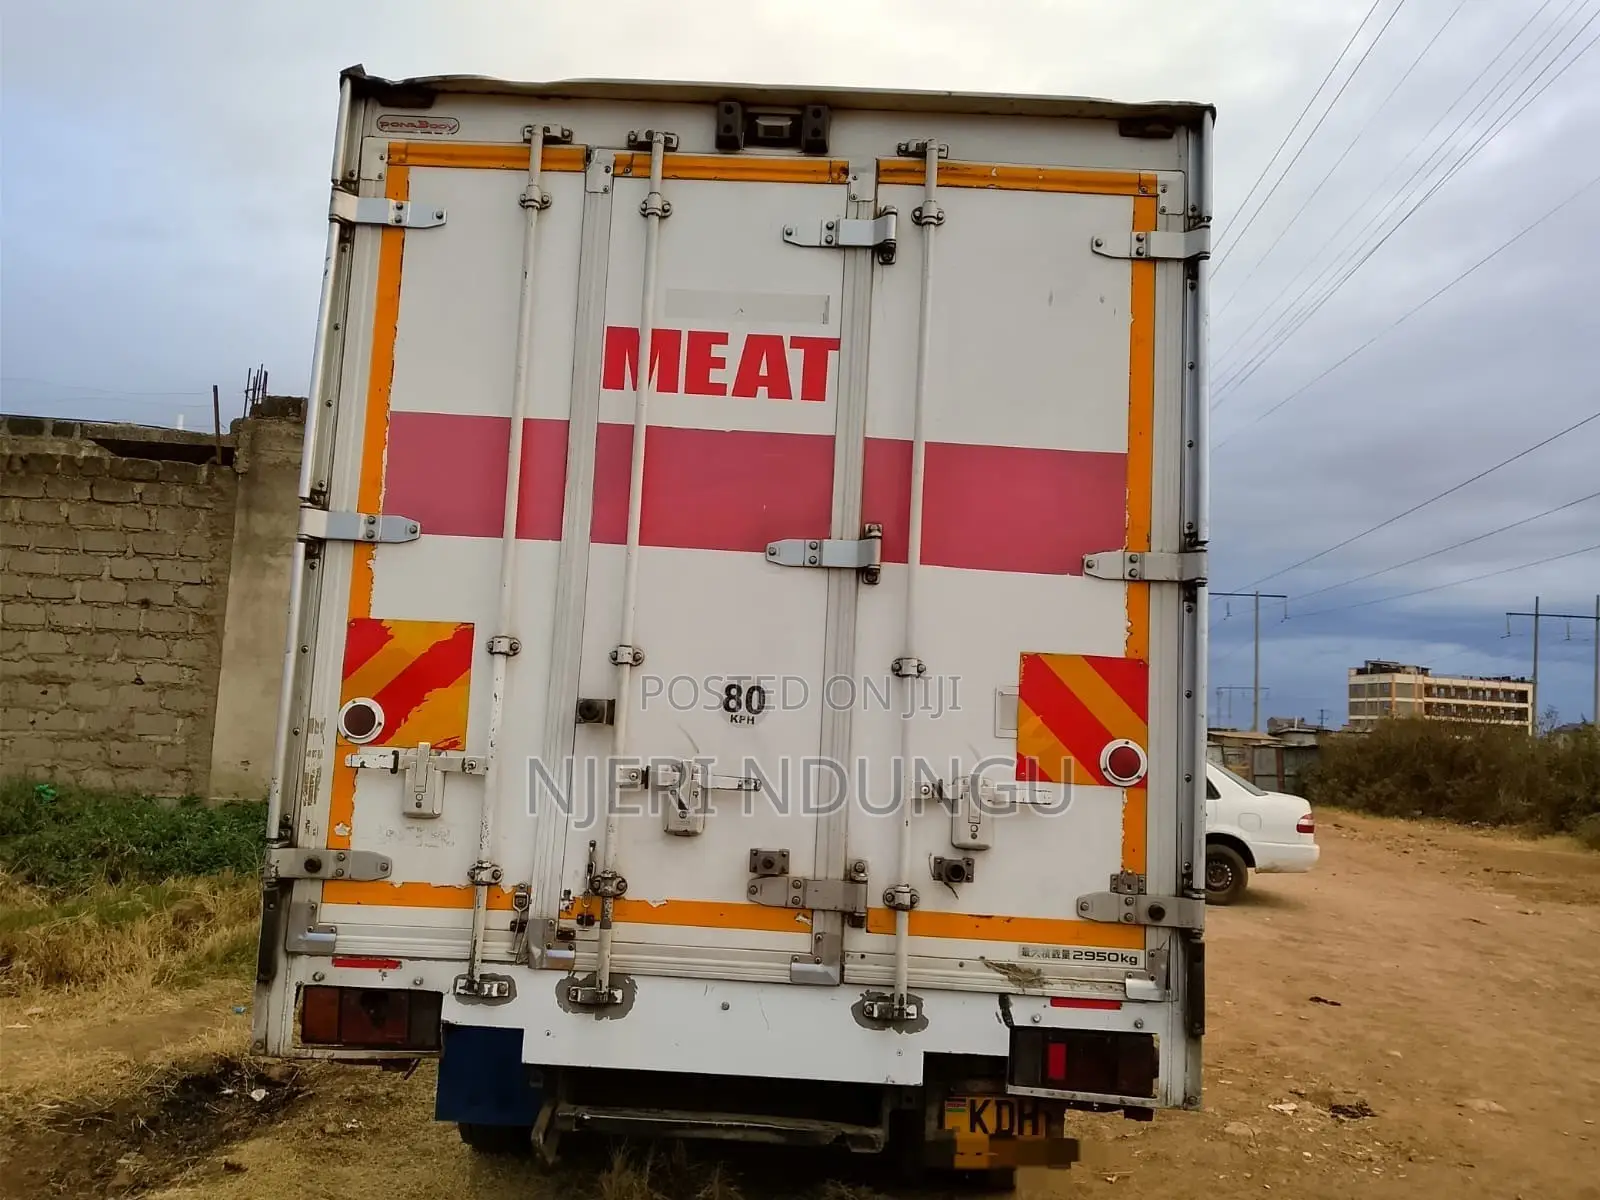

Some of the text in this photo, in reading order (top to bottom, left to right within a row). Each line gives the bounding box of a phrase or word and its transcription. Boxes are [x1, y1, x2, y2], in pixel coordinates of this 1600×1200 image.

[602, 325, 841, 402] MEAT
[722, 683, 767, 715] 80
[729, 713, 755, 725] KPH
[1072, 950, 1138, 966] 2950kg
[969, 1098, 1040, 1137] KDH
